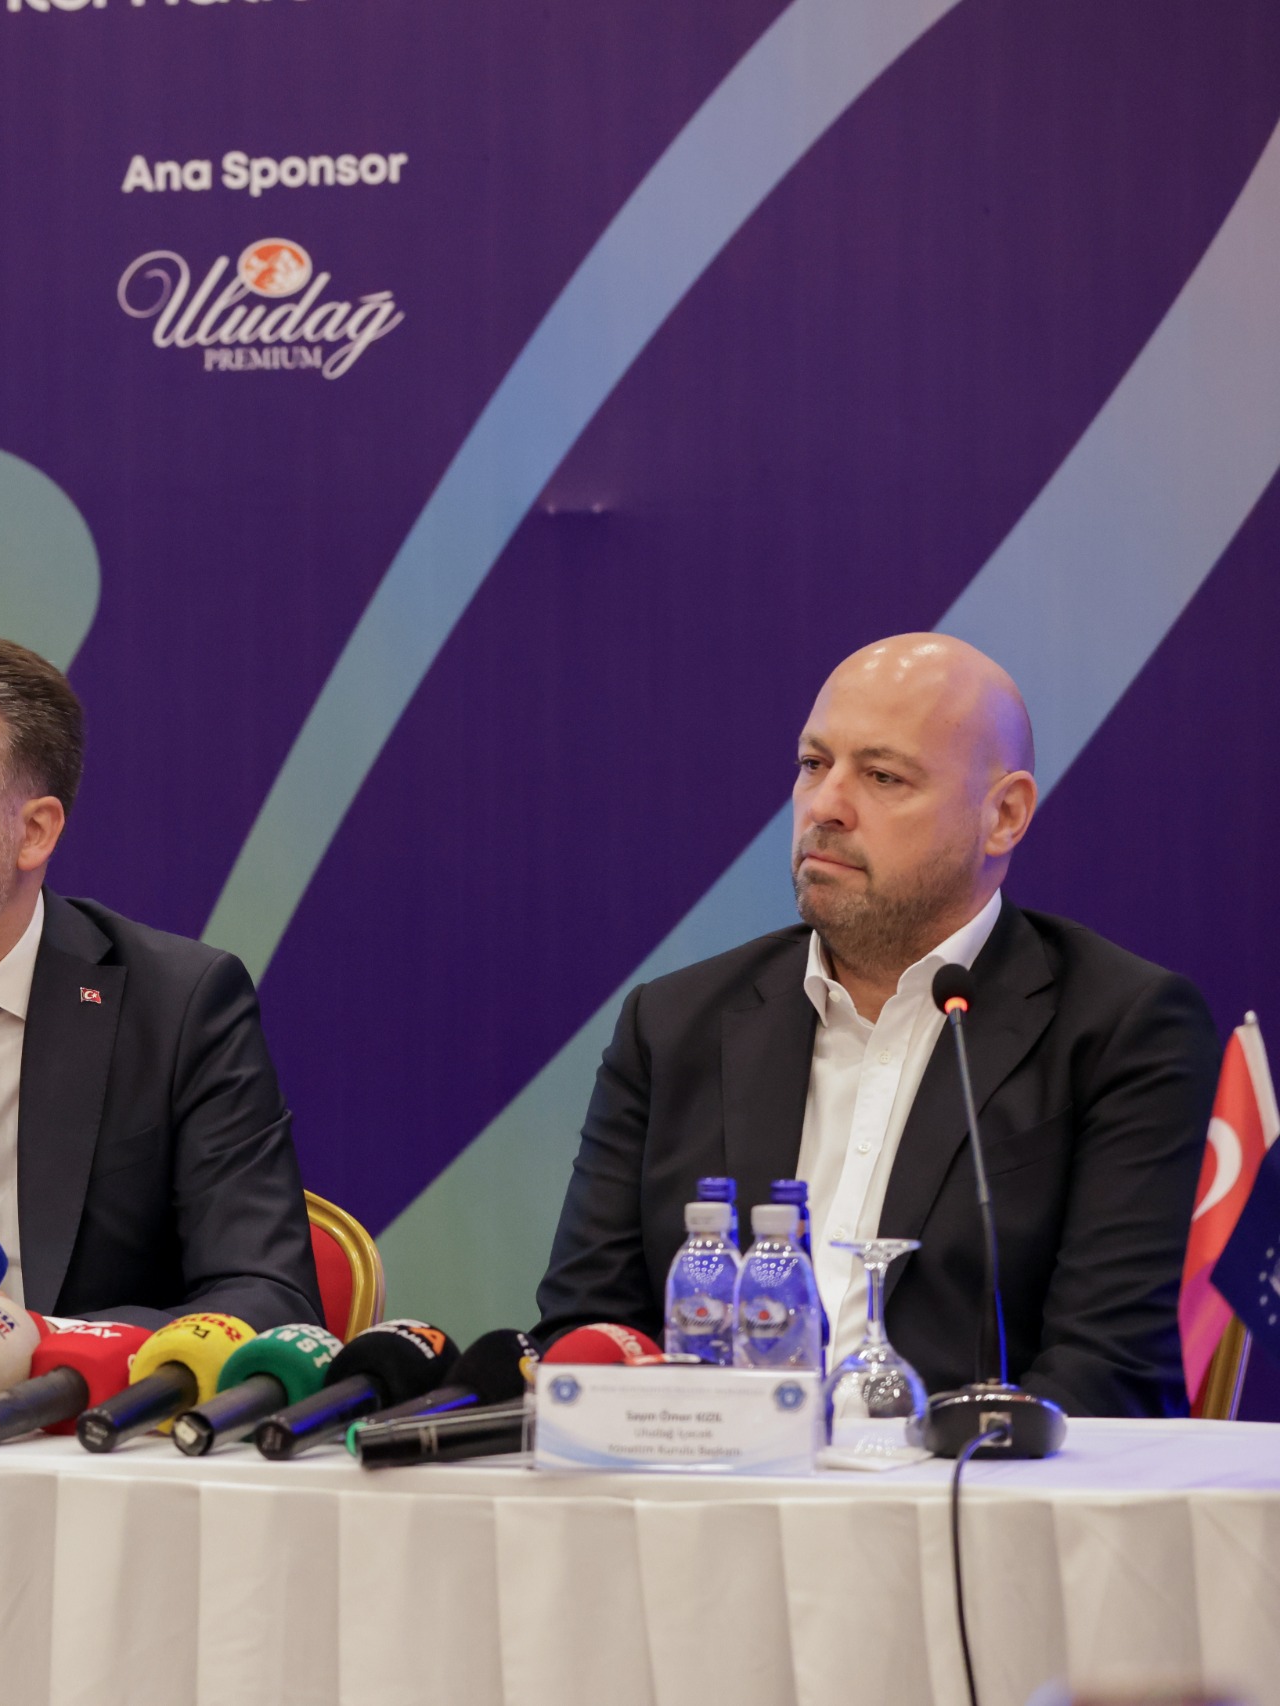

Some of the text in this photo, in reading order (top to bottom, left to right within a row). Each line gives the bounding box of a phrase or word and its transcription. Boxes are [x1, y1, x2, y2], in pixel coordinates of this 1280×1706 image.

[121, 151, 409, 198] Ana Sponsor
[117, 250, 405, 380] Uludağ
[204, 346, 323, 372] PREMIUM
